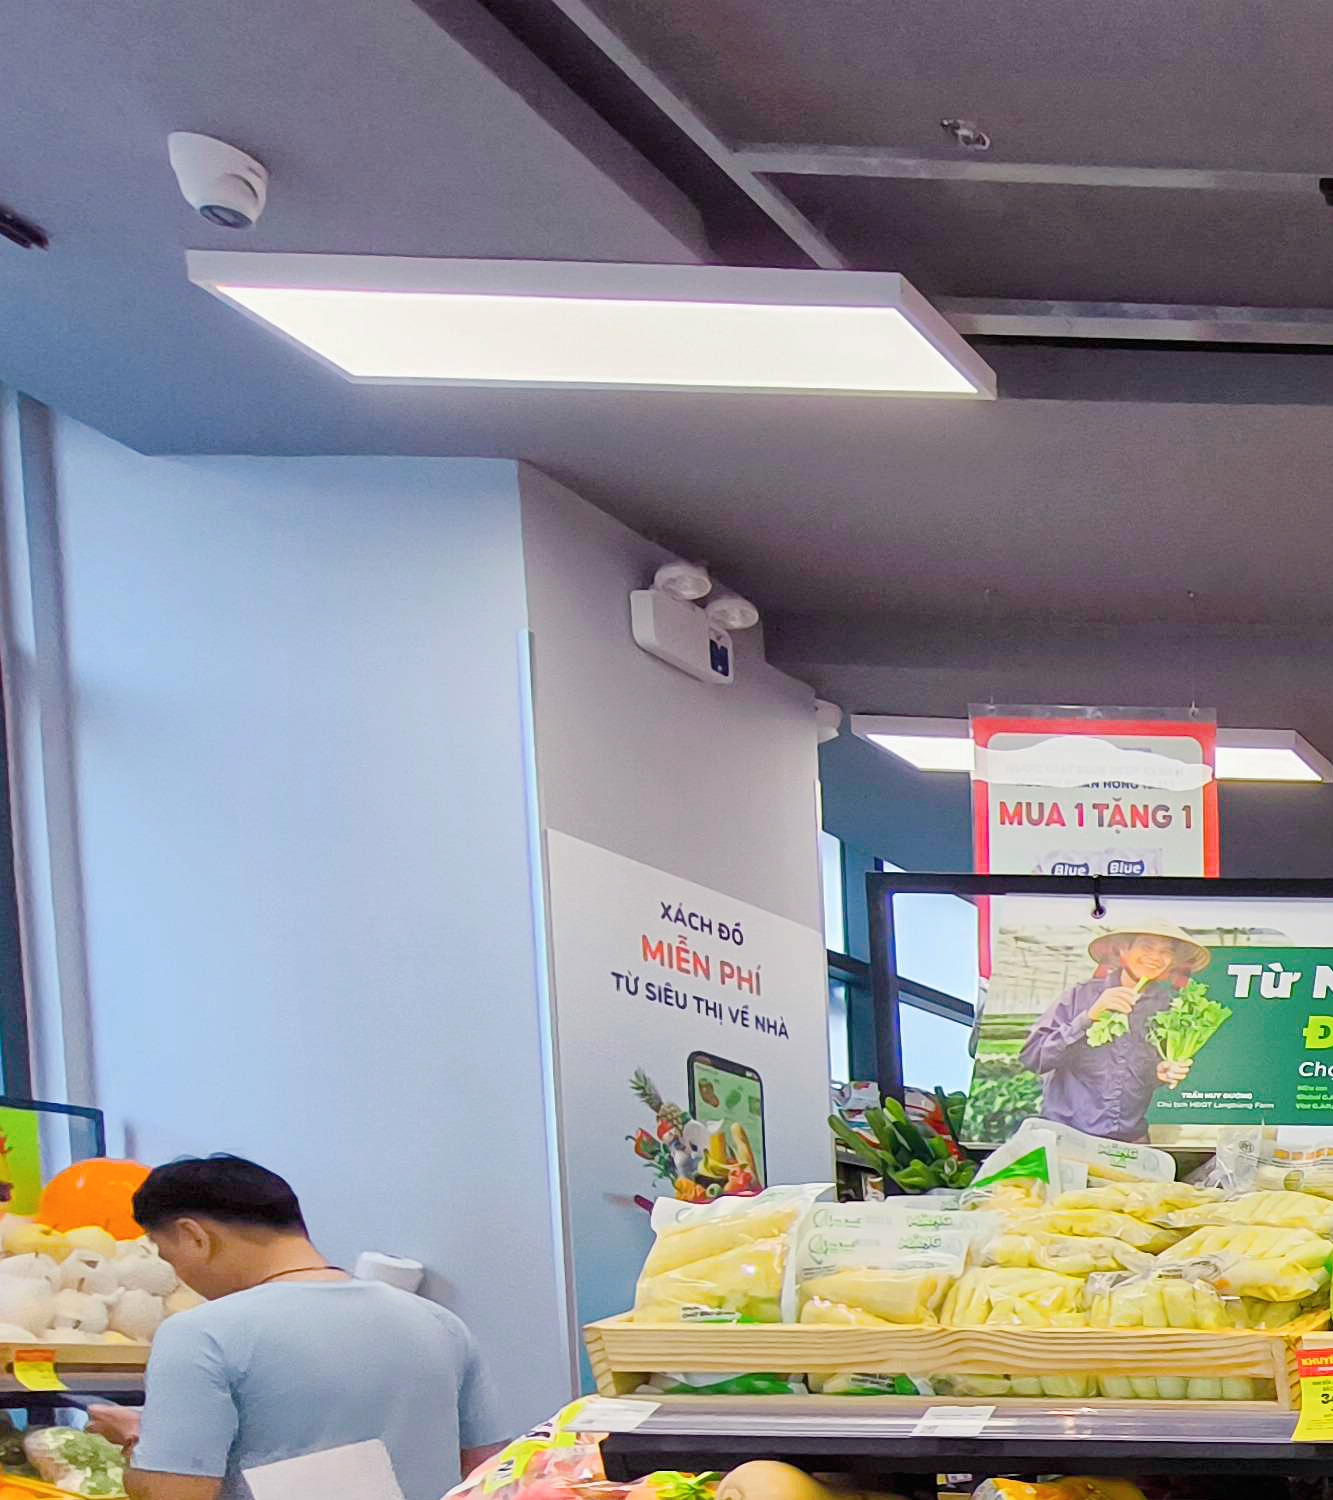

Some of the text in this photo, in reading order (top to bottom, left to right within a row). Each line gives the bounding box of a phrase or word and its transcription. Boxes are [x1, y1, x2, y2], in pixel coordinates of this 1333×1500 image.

[999, 797, 1192, 834] MUA 1 TẶNG 1
[1053, 862, 1088, 875] Blue
[1108, 859, 1144, 875] Blue
[660, 901, 713, 936] XÁCH
[641, 934, 762, 996] MIỄN PHÍ
[1227, 963, 1301, 999] Từ
[611, 971, 789, 1040] TỪ SIÊU THỊ VỀ NHÀ
